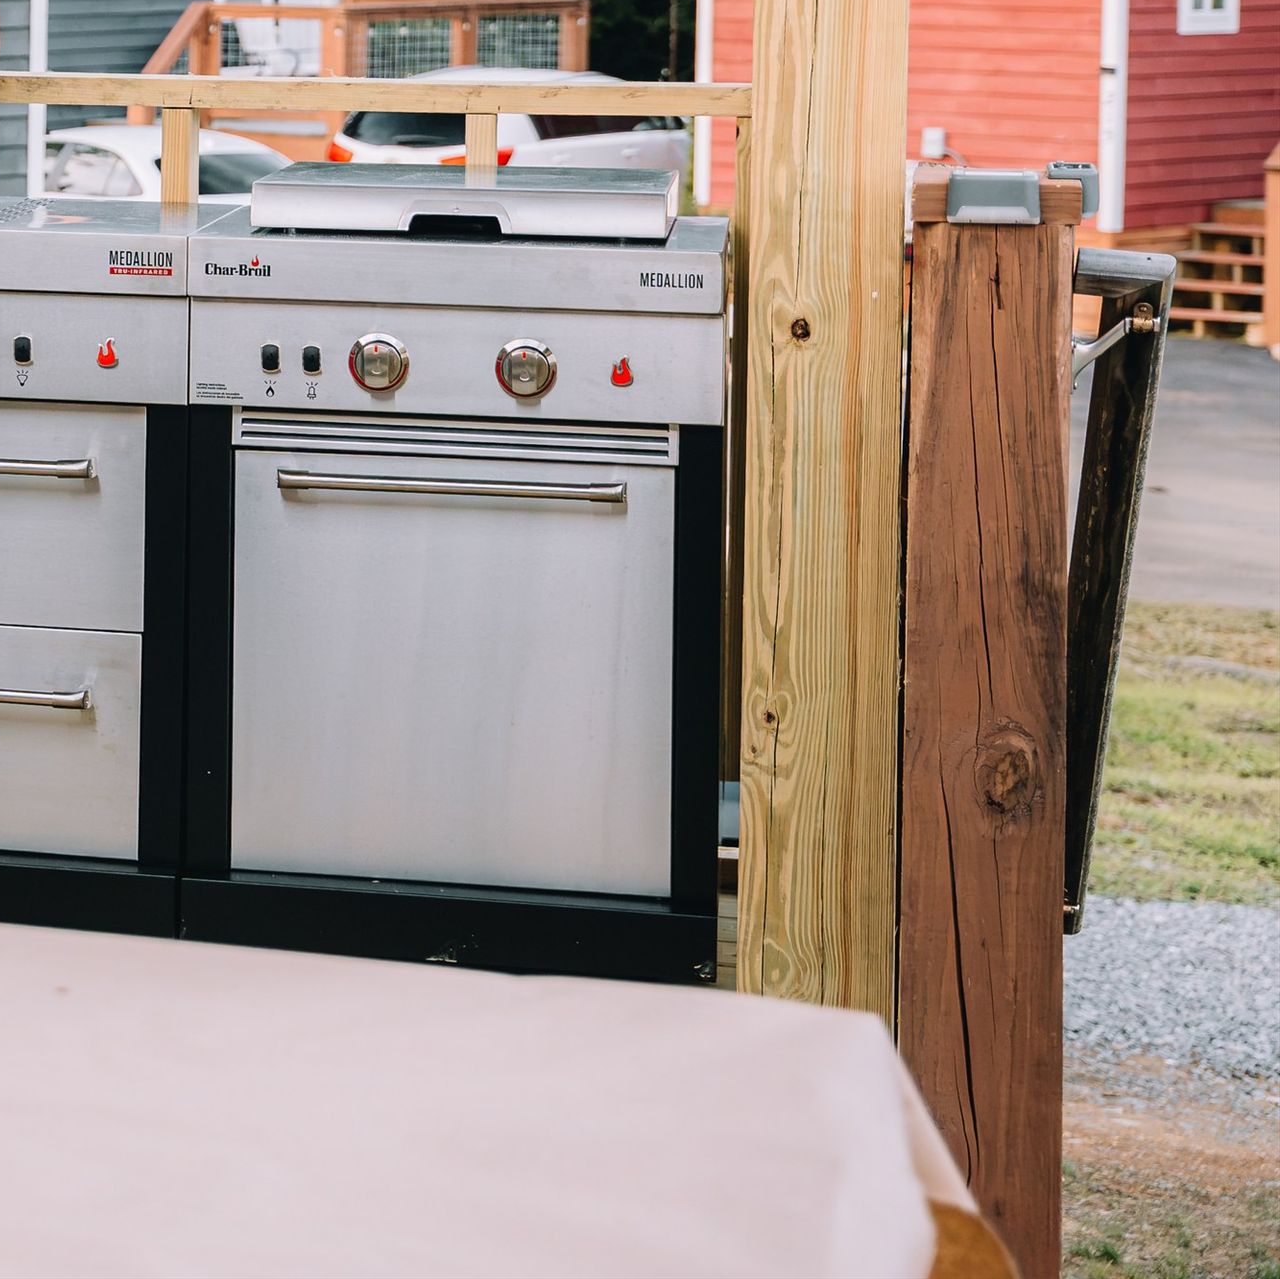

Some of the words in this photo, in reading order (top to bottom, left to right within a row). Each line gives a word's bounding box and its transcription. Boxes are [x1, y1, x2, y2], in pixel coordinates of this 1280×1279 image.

[109, 250, 173, 267] MEDALLION
[112, 268, 170, 276] TRU-INFRARED
[204, 261, 271, 277] Char-Broil
[640, 272, 704, 289] MEDALLION
